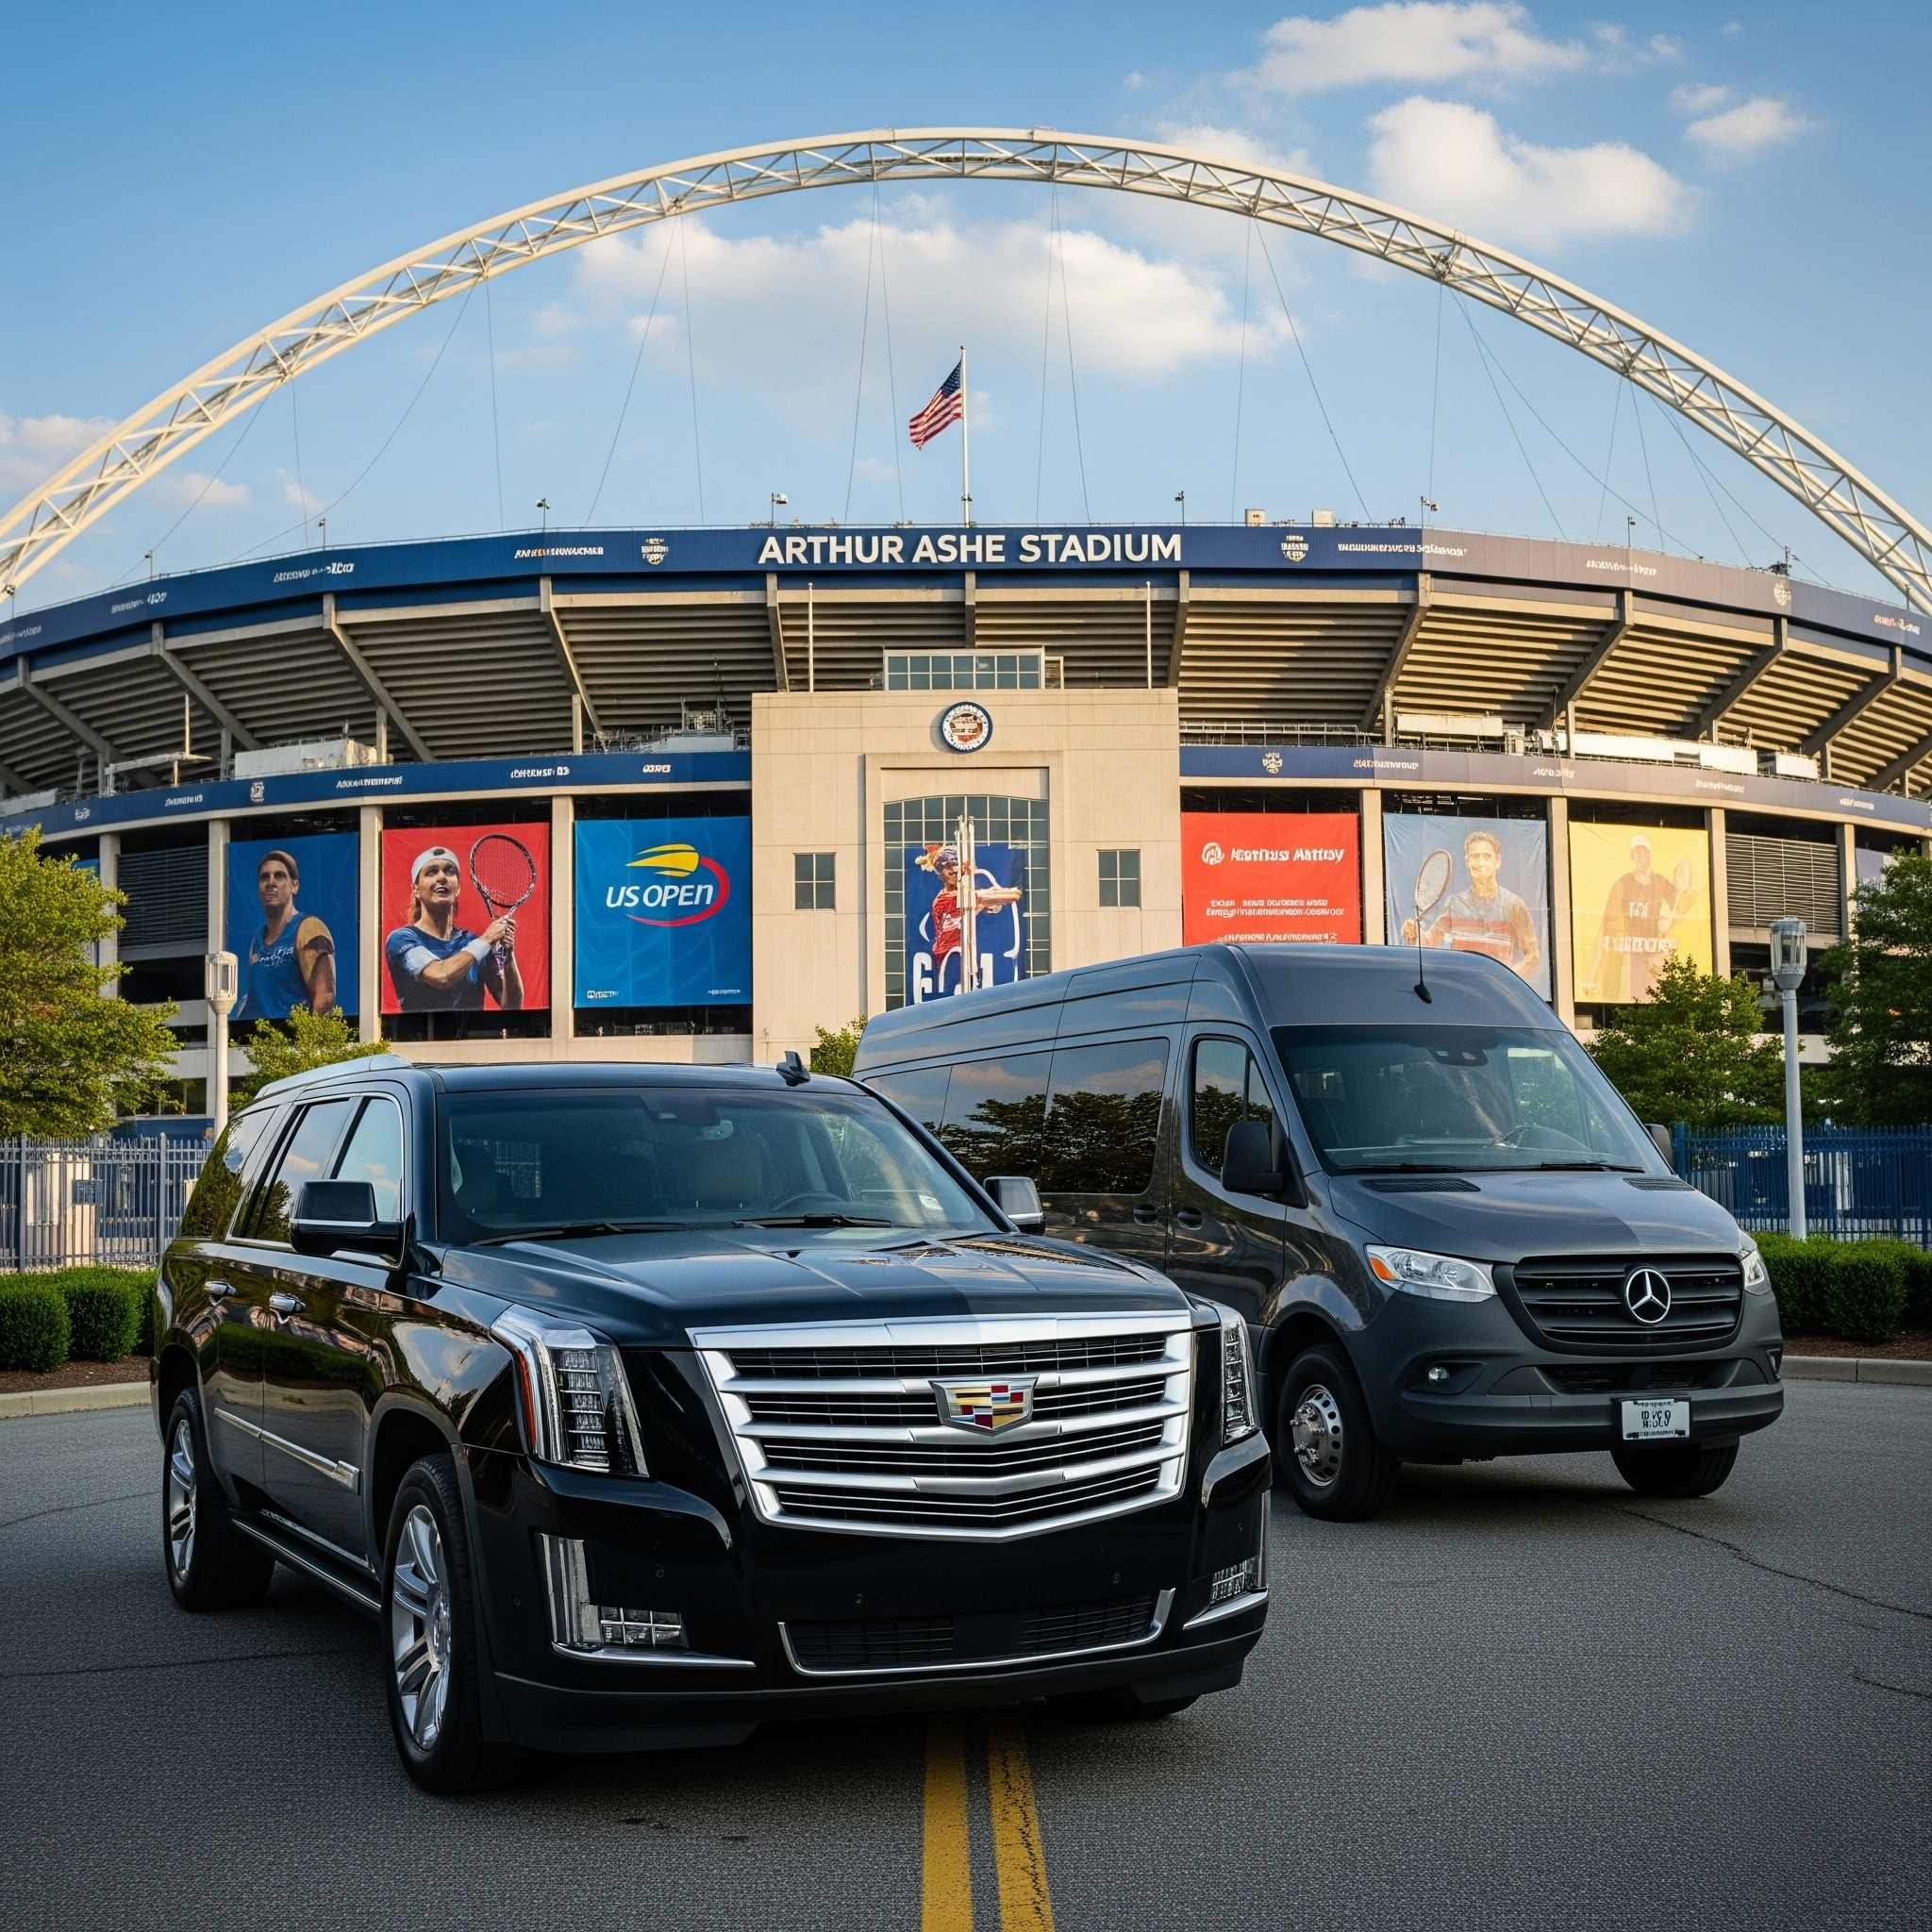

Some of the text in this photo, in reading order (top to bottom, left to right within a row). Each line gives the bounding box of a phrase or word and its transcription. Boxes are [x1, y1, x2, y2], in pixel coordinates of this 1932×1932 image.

[758, 533, 1182, 564] ARTHUR ASHE STADIUM
[606, 883, 714, 908] US OPEN
